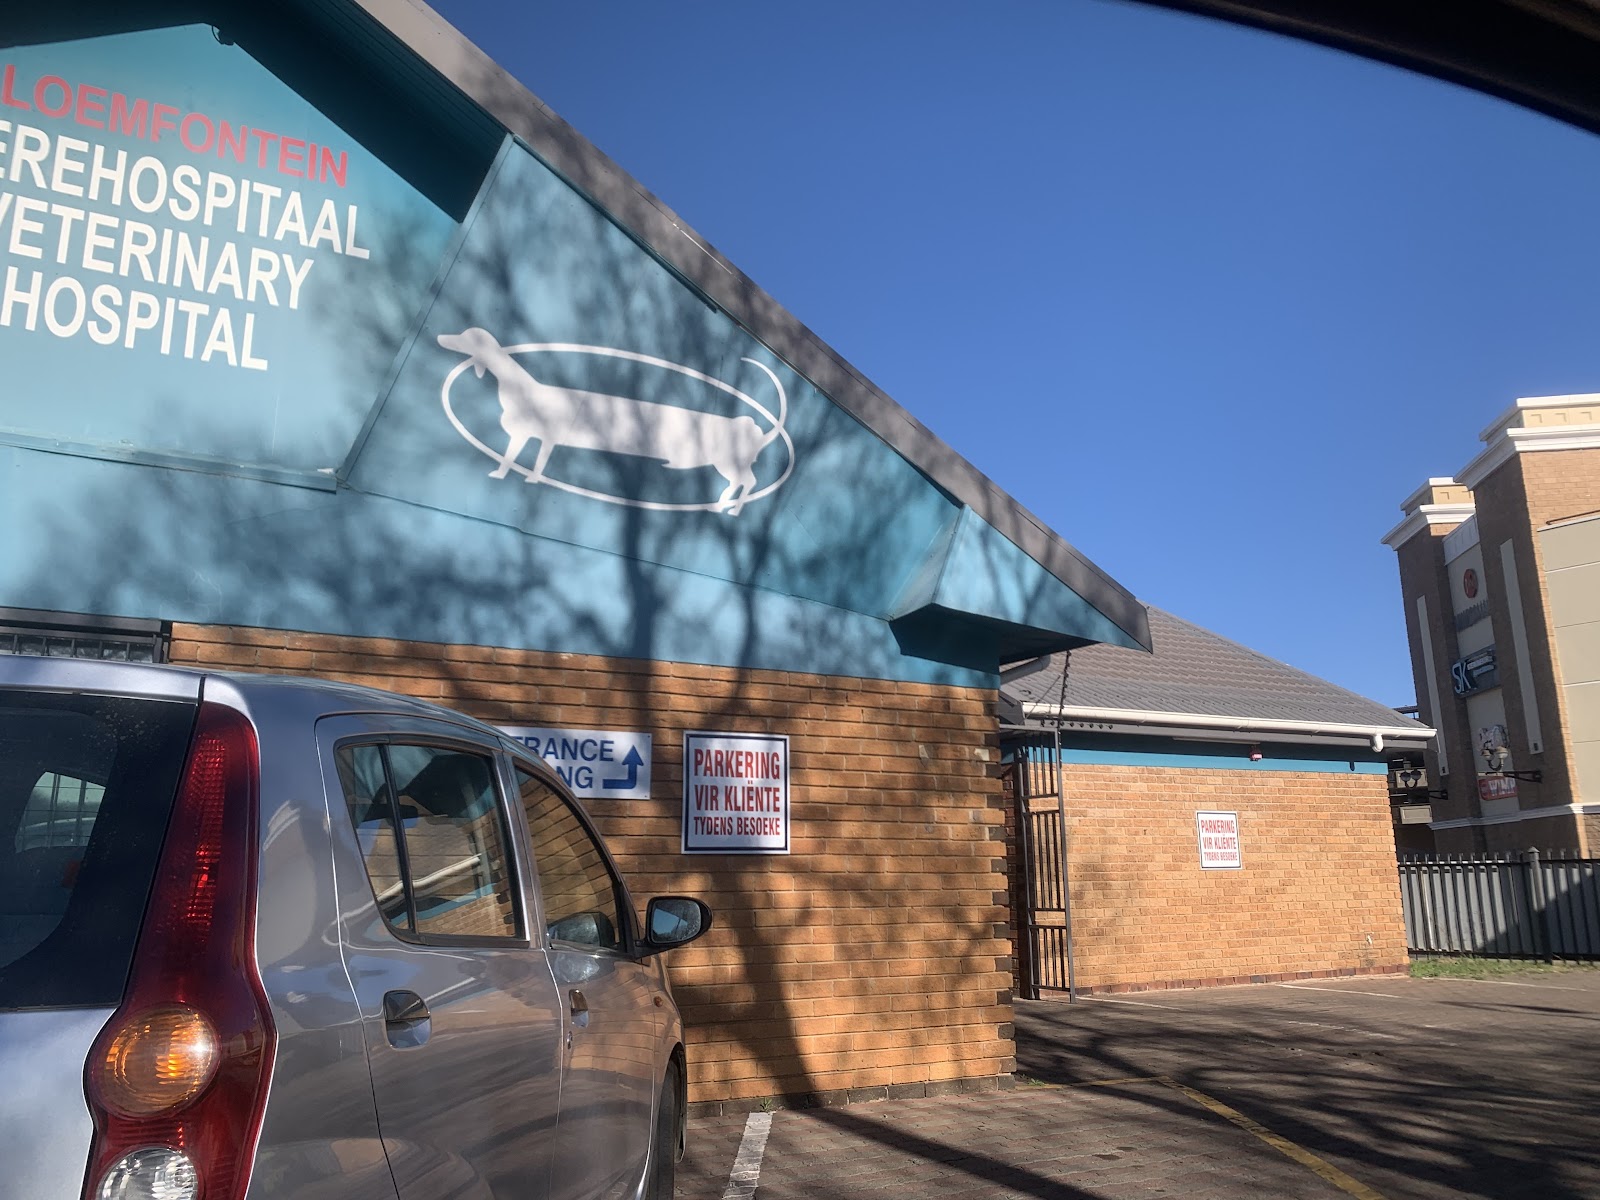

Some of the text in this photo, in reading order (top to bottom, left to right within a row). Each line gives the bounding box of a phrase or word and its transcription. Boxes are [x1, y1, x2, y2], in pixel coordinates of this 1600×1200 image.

[0, 265, 268, 371] HOSPITAL
[513, 735, 615, 762] RANCE
[694, 748, 780, 780] PARKERING
[694, 780, 780, 812] VIR KLIËNTE
[693, 816, 780, 836] TYDENS BESOEKE
[1200, 819, 1235, 834] PARKERING
[1203, 836, 1213, 849] VIR
